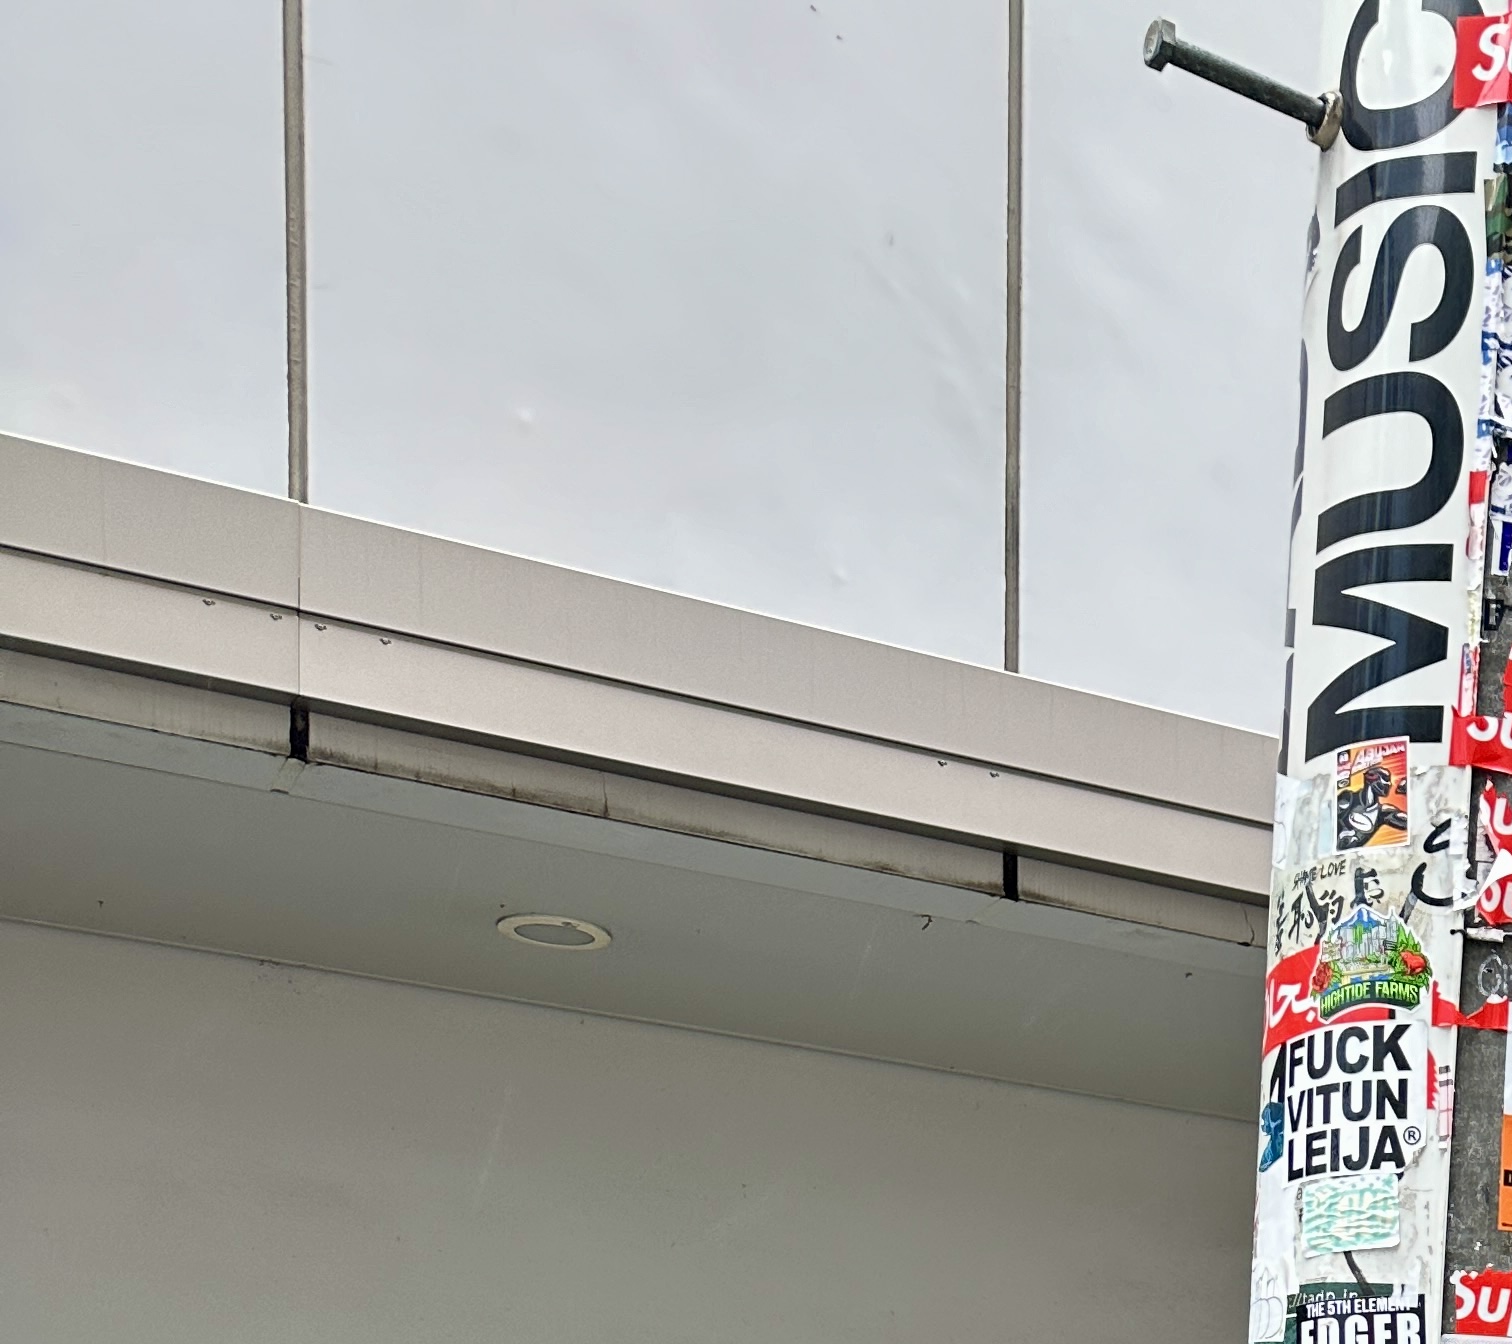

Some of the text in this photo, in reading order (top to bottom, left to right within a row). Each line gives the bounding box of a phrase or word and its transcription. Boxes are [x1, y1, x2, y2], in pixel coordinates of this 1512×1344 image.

[1305, 0, 1483, 764] MUSIC
[1320, 982, 1370, 1014] HIGHTIDE
[1375, 983, 1419, 1004] FARMS
[1288, 1024, 1412, 1088] FUCK
[1287, 1078, 1409, 1133] VITUN
[1306, 1302, 1325, 1318] THE
[1327, 1299, 1352, 1315] 5TH
